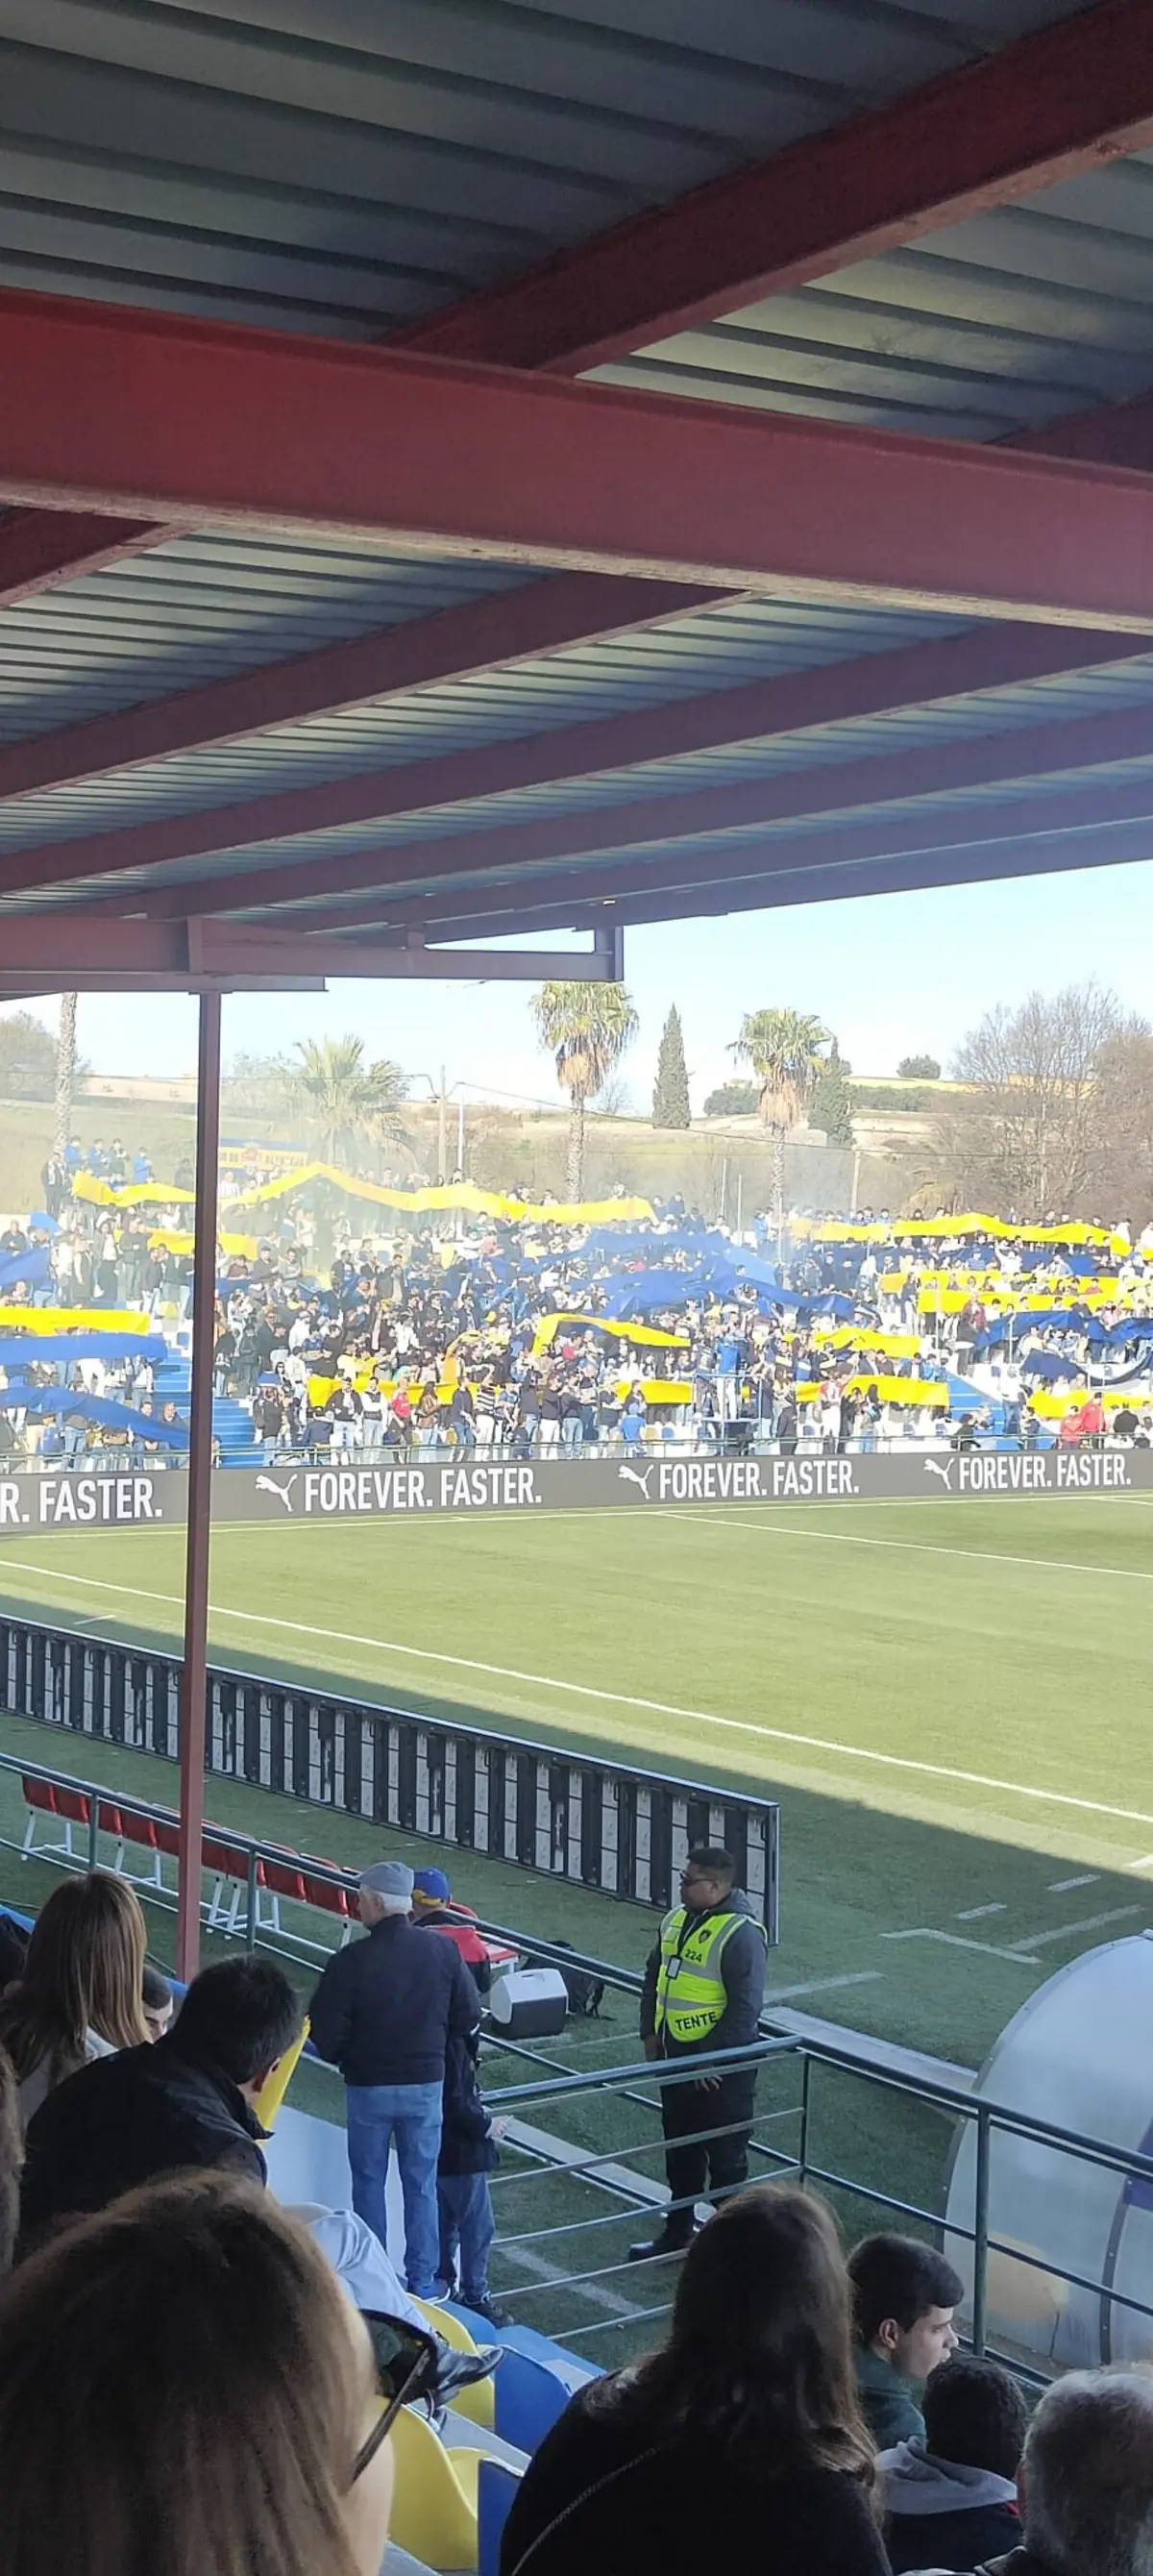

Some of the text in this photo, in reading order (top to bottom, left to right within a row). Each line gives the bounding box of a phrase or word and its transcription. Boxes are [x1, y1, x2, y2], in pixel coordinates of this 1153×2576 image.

[304, 1467, 543, 1513] FOREVER. FASTER.
[659, 1459, 860, 1499] FOREVER. FASTER.
[958, 1453, 1133, 1491] FOREVER. FASTER.
[38, 1477, 163, 1523] FASTER.
[684, 1948, 702, 1963] 224
[675, 2012, 718, 2032] TENTE
